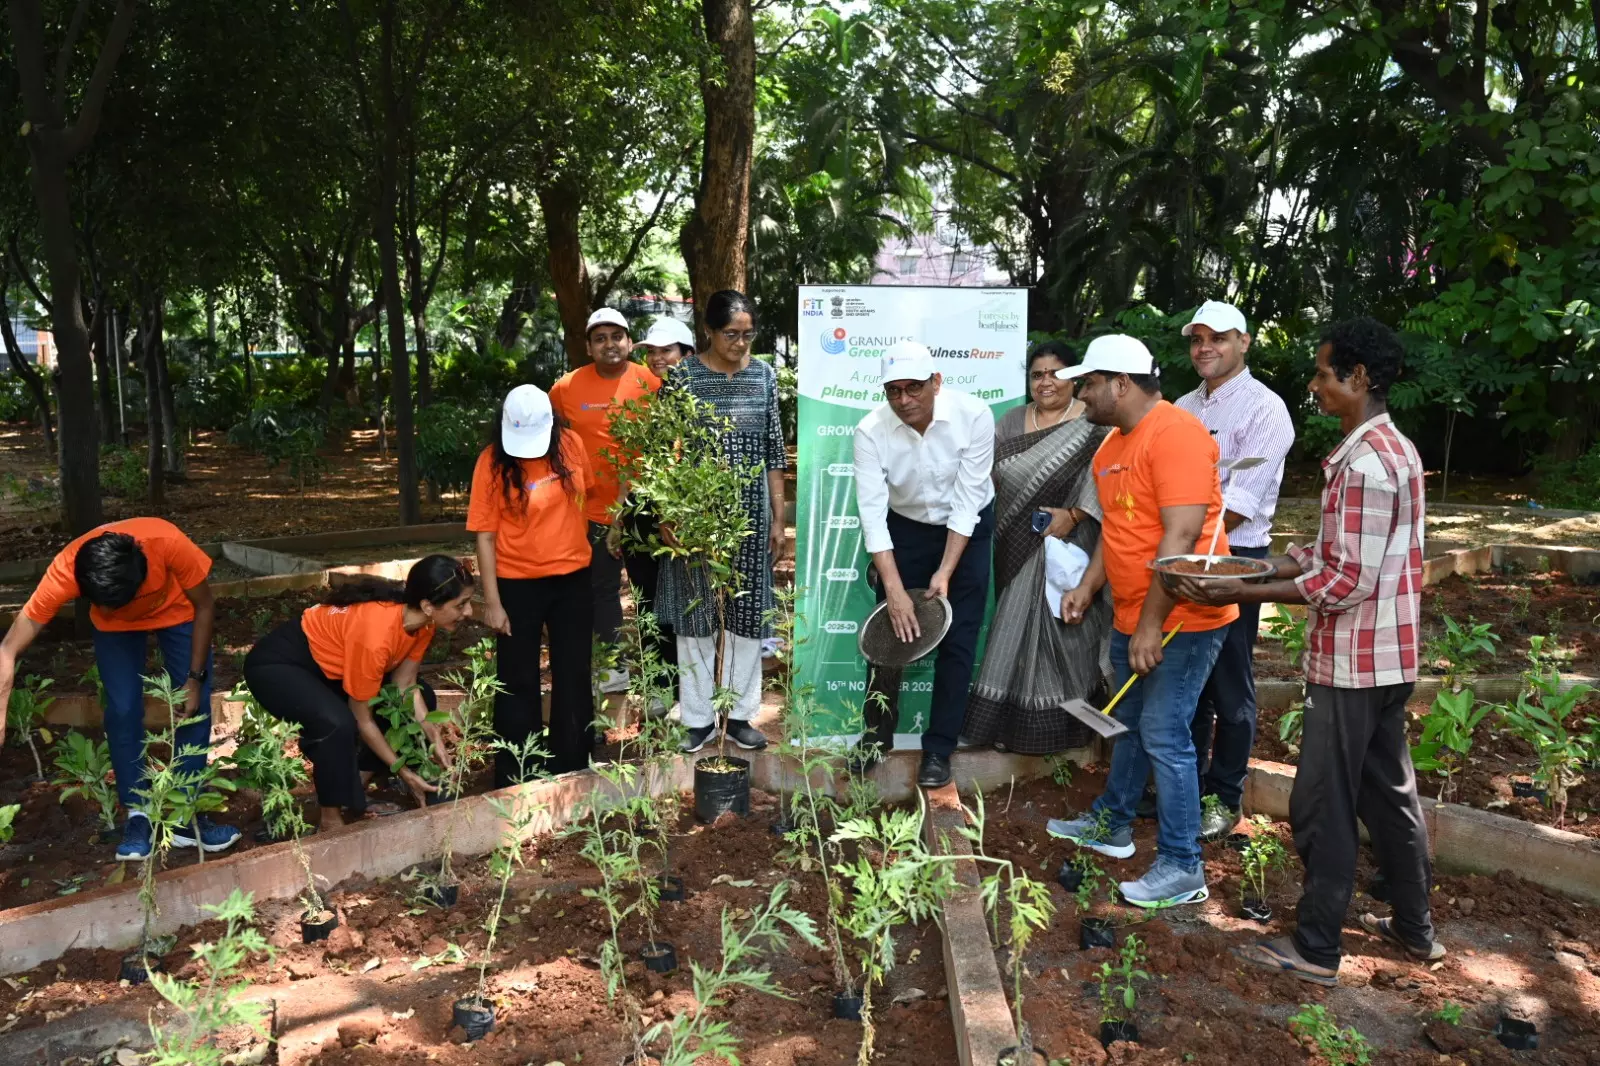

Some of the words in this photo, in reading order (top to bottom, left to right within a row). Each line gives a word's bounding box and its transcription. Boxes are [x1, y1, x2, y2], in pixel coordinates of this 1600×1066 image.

[978, 320, 1019, 332] heartfulness
[850, 371, 859, 381] A
[957, 375, 978, 384] our
[821, 385, 868, 399] planet
